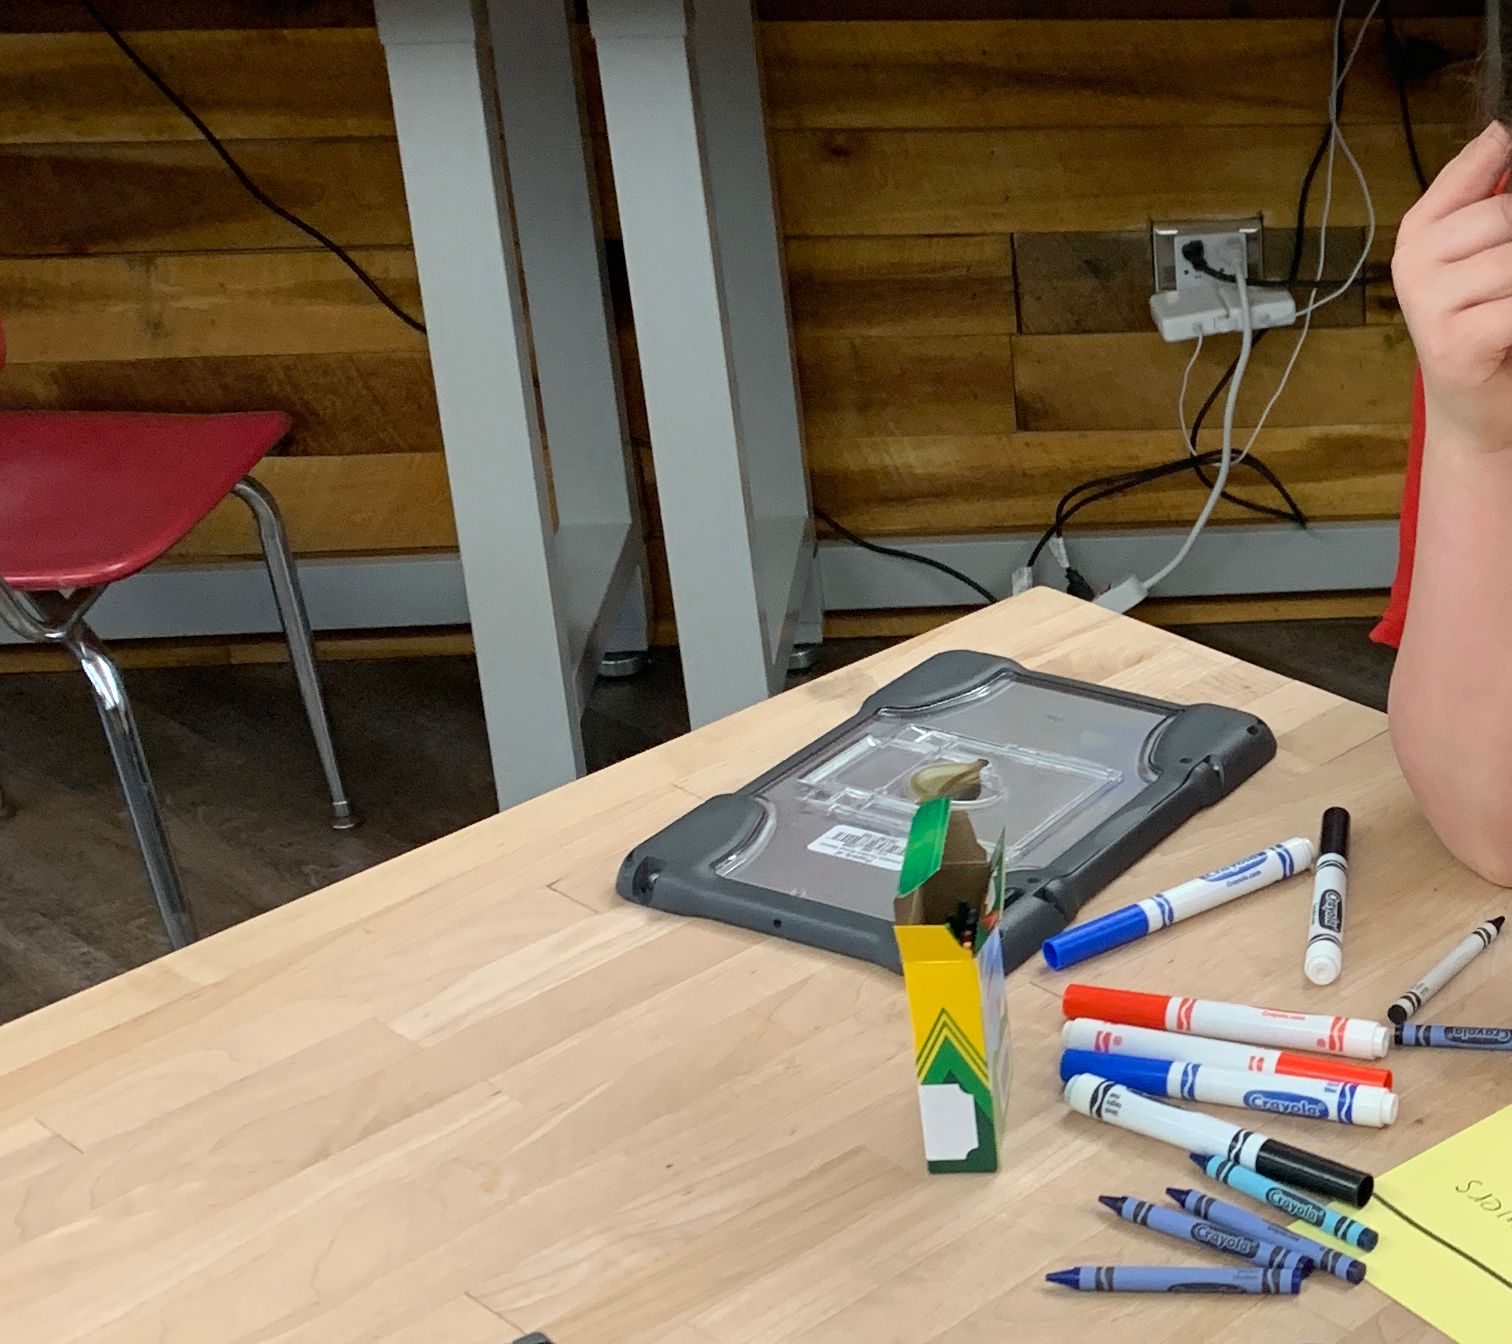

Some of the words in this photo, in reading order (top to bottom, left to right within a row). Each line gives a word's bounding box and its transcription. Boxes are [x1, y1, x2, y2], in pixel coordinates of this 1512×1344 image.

[1248, 1093, 1323, 1118] Crayola
[1268, 1189, 1326, 1223] Crayola
[1194, 1223, 1258, 1256] Crayola
